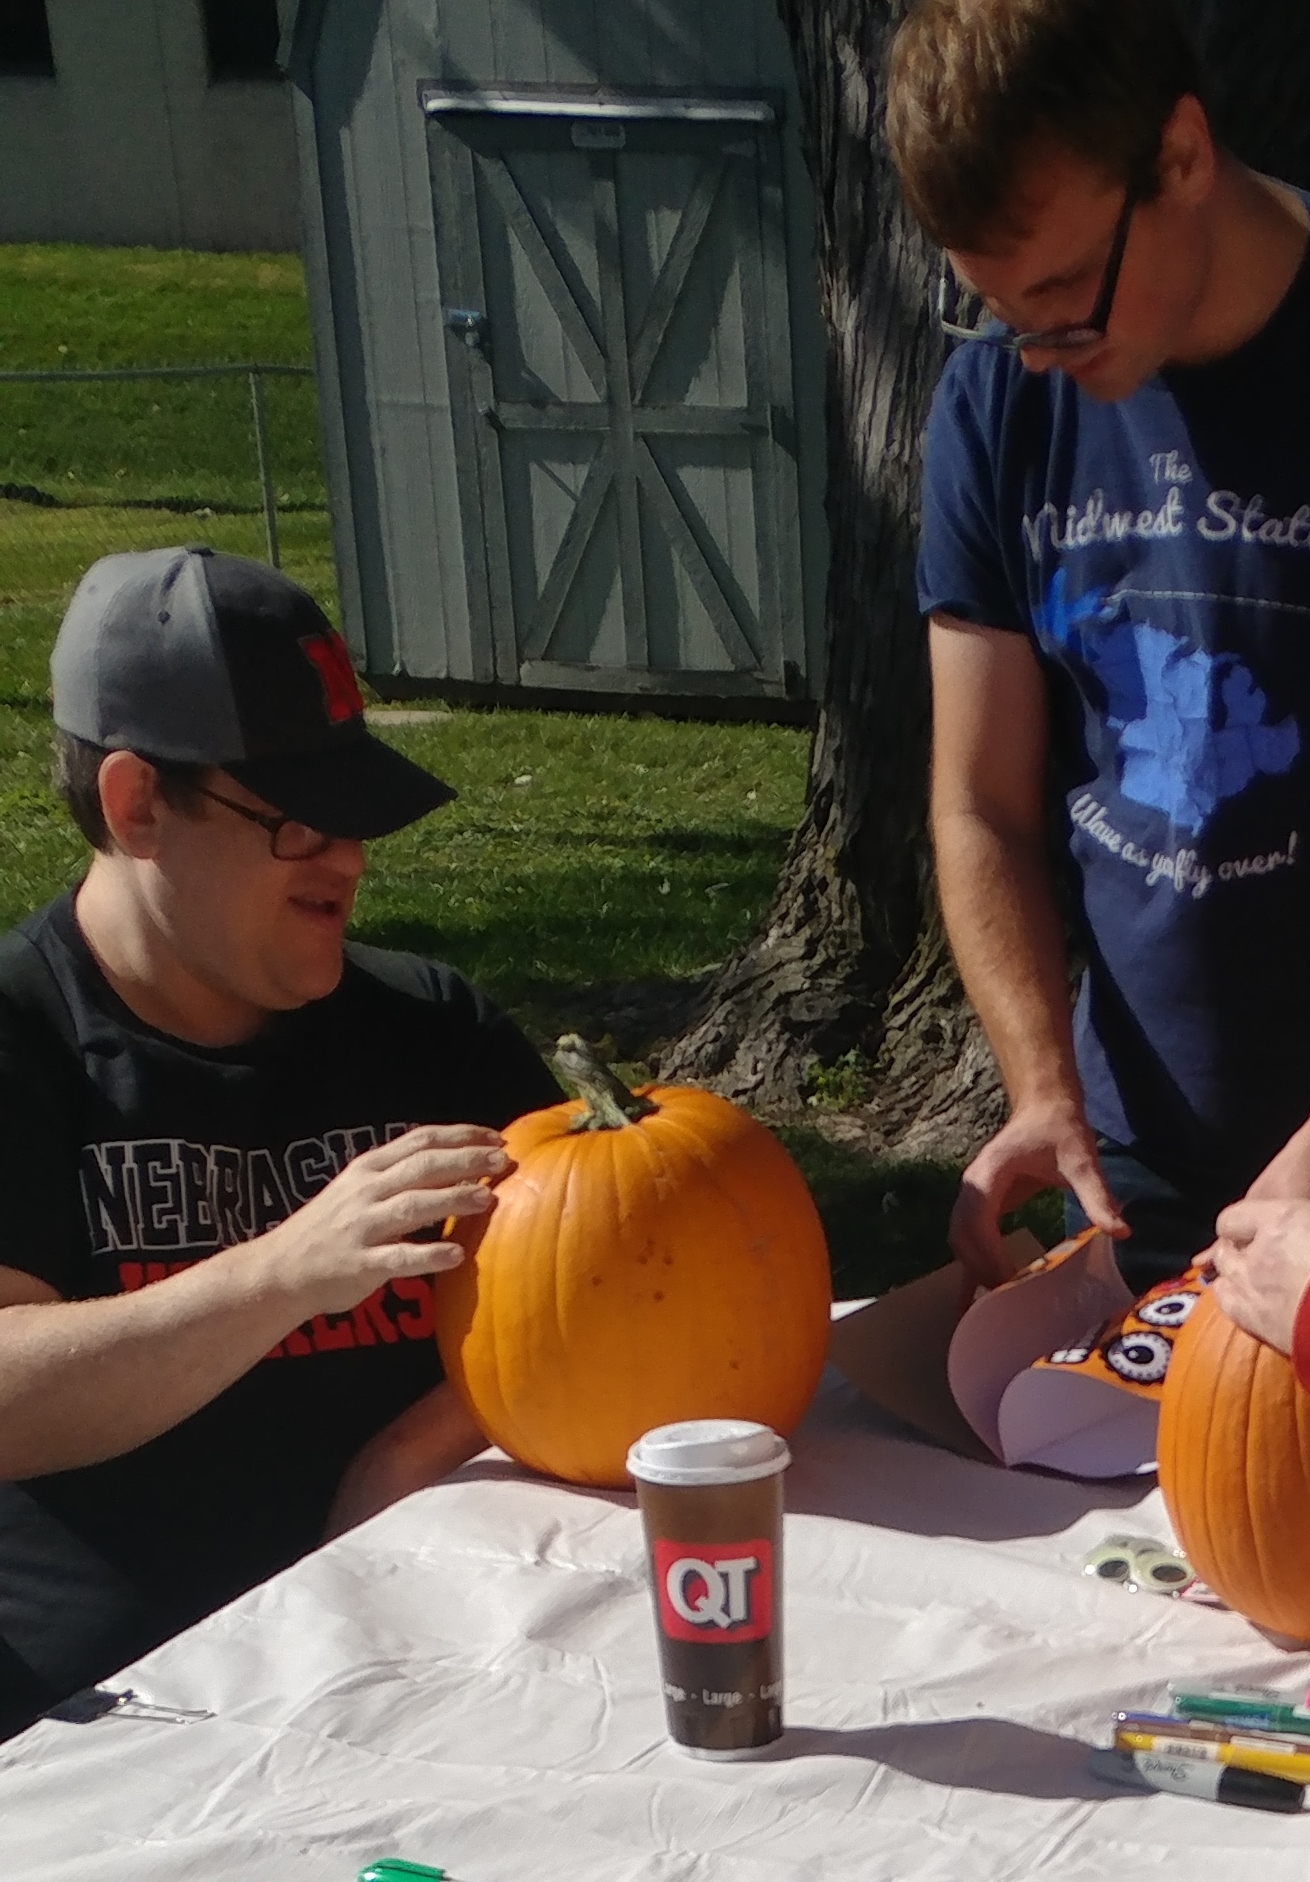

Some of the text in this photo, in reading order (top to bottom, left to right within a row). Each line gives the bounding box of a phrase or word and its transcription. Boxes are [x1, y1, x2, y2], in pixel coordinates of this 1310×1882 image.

[1149, 449, 1193, 484] The
[1218, 830, 1299, 881] over!
[78, 1122, 422, 1256] NEBRAS
[666, 1556, 758, 1629] QT
[702, 1688, 743, 1709] Large
